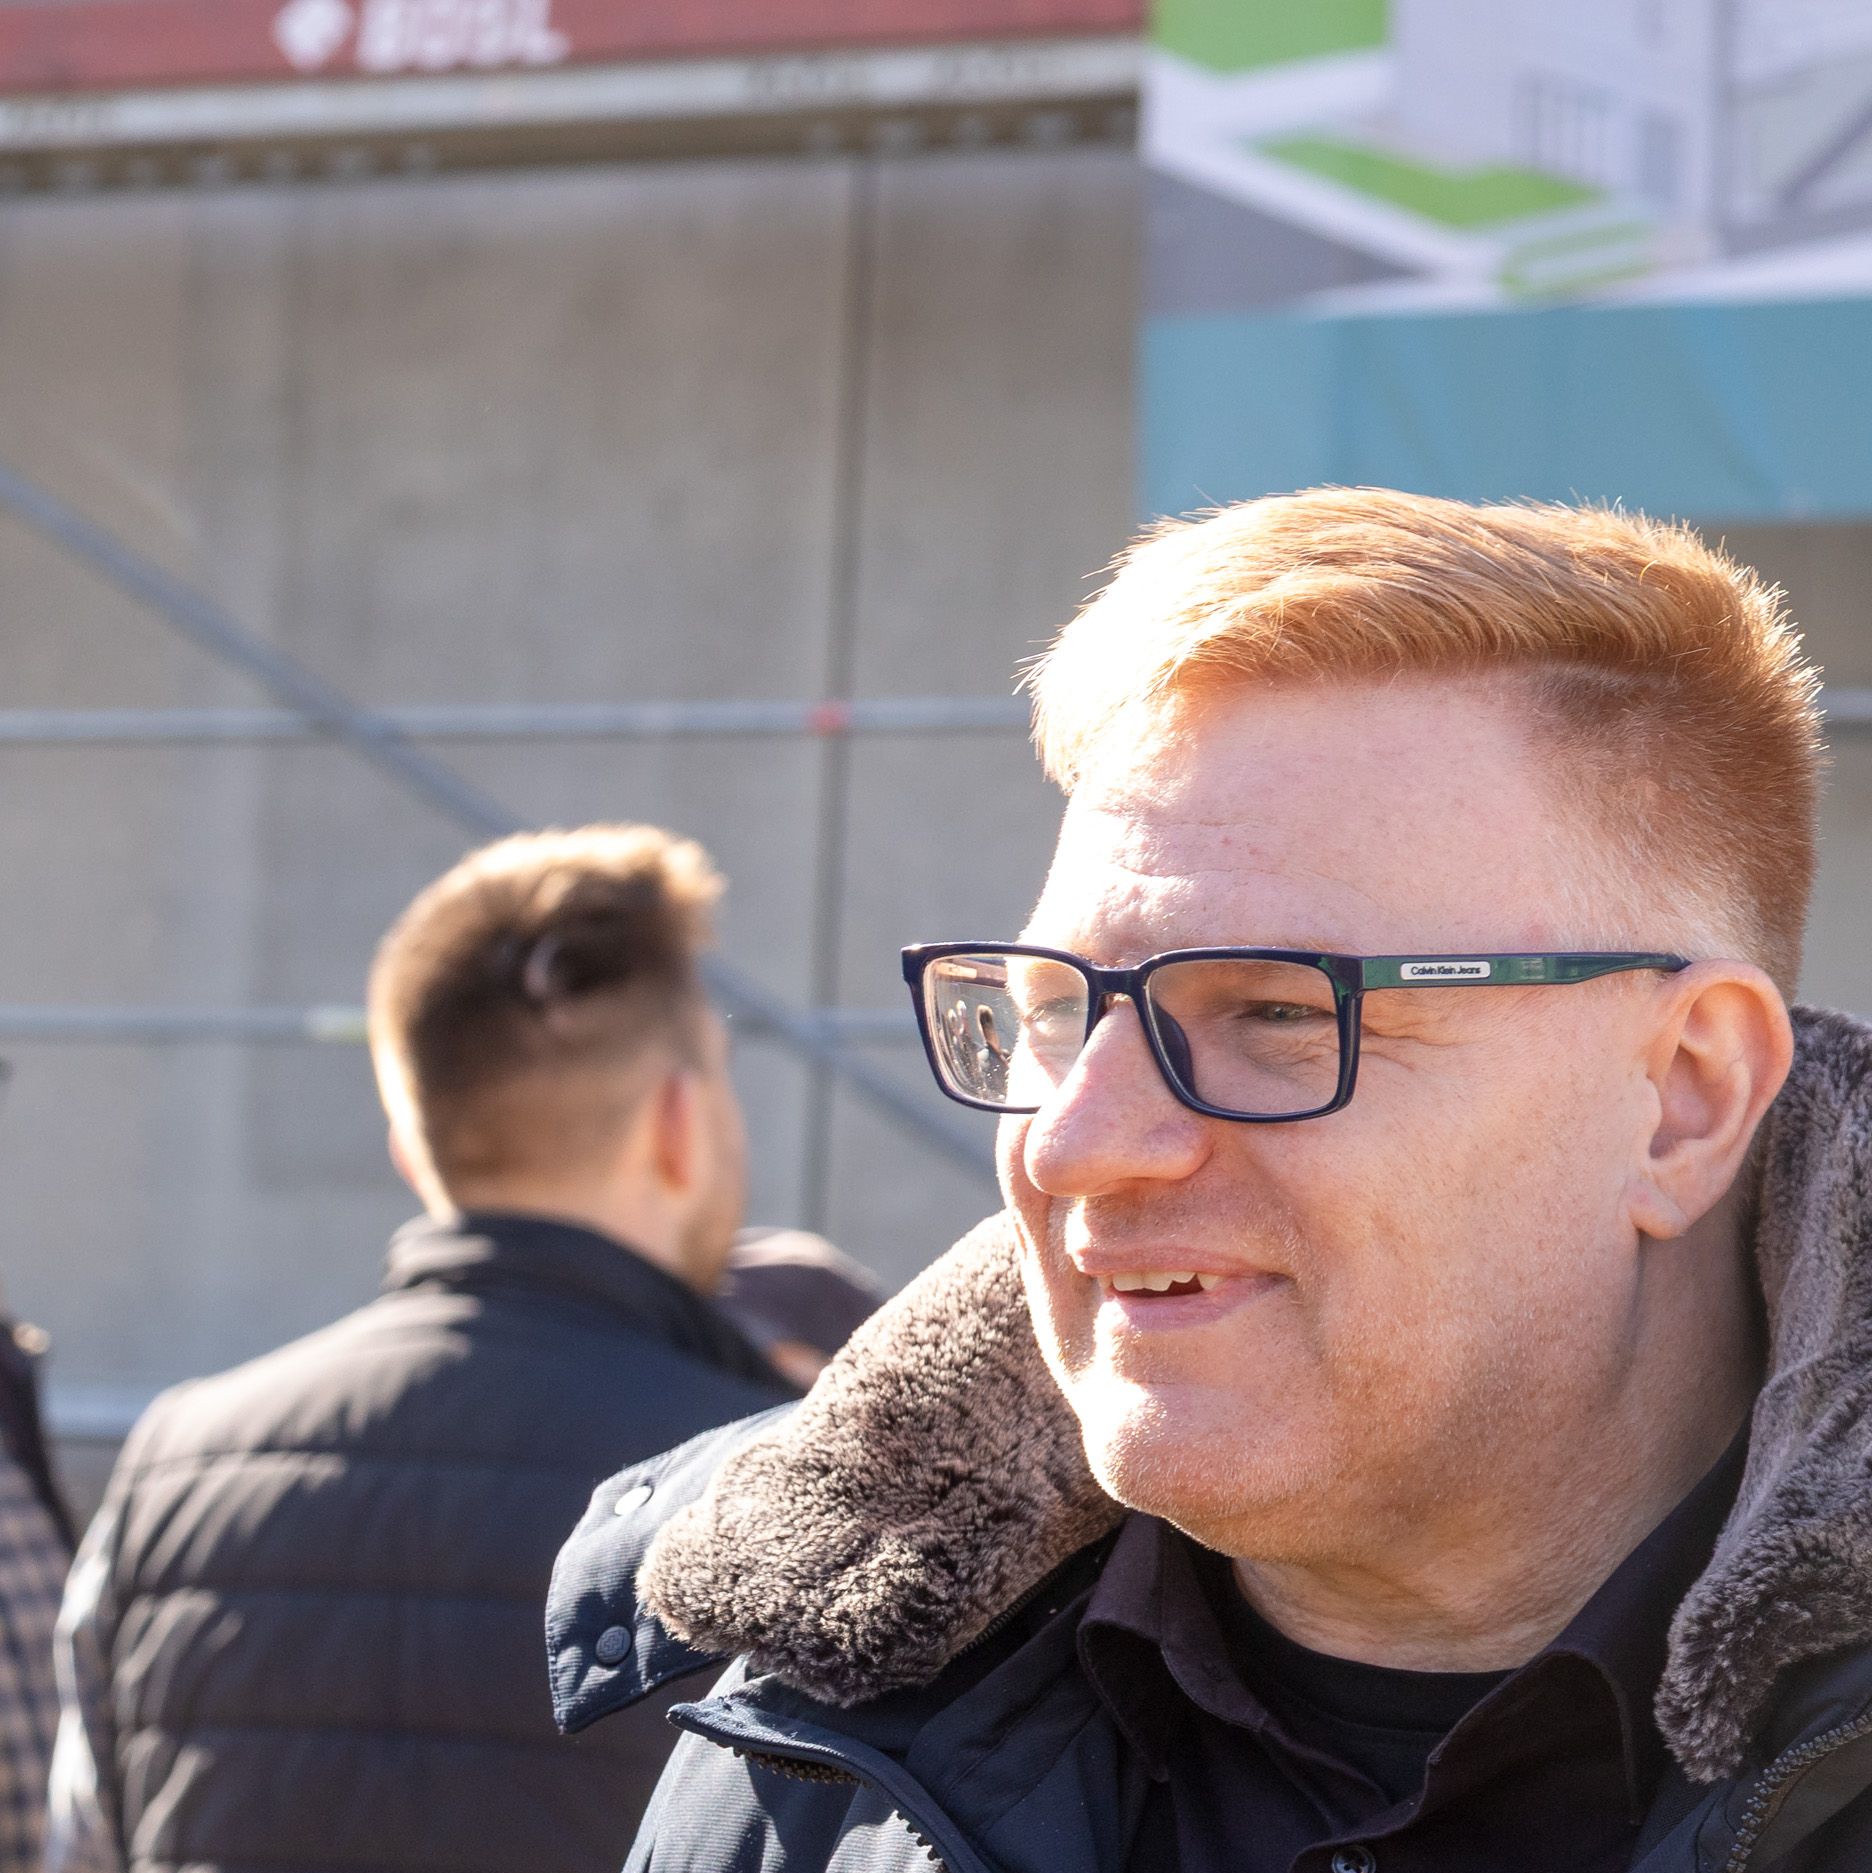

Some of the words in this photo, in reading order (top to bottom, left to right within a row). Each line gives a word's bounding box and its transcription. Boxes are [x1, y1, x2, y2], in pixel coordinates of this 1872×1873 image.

[1410, 966, 1436, 976] Calvin
[1437, 965, 1456, 975] Klein
[1457, 965, 1481, 975] Jeans
